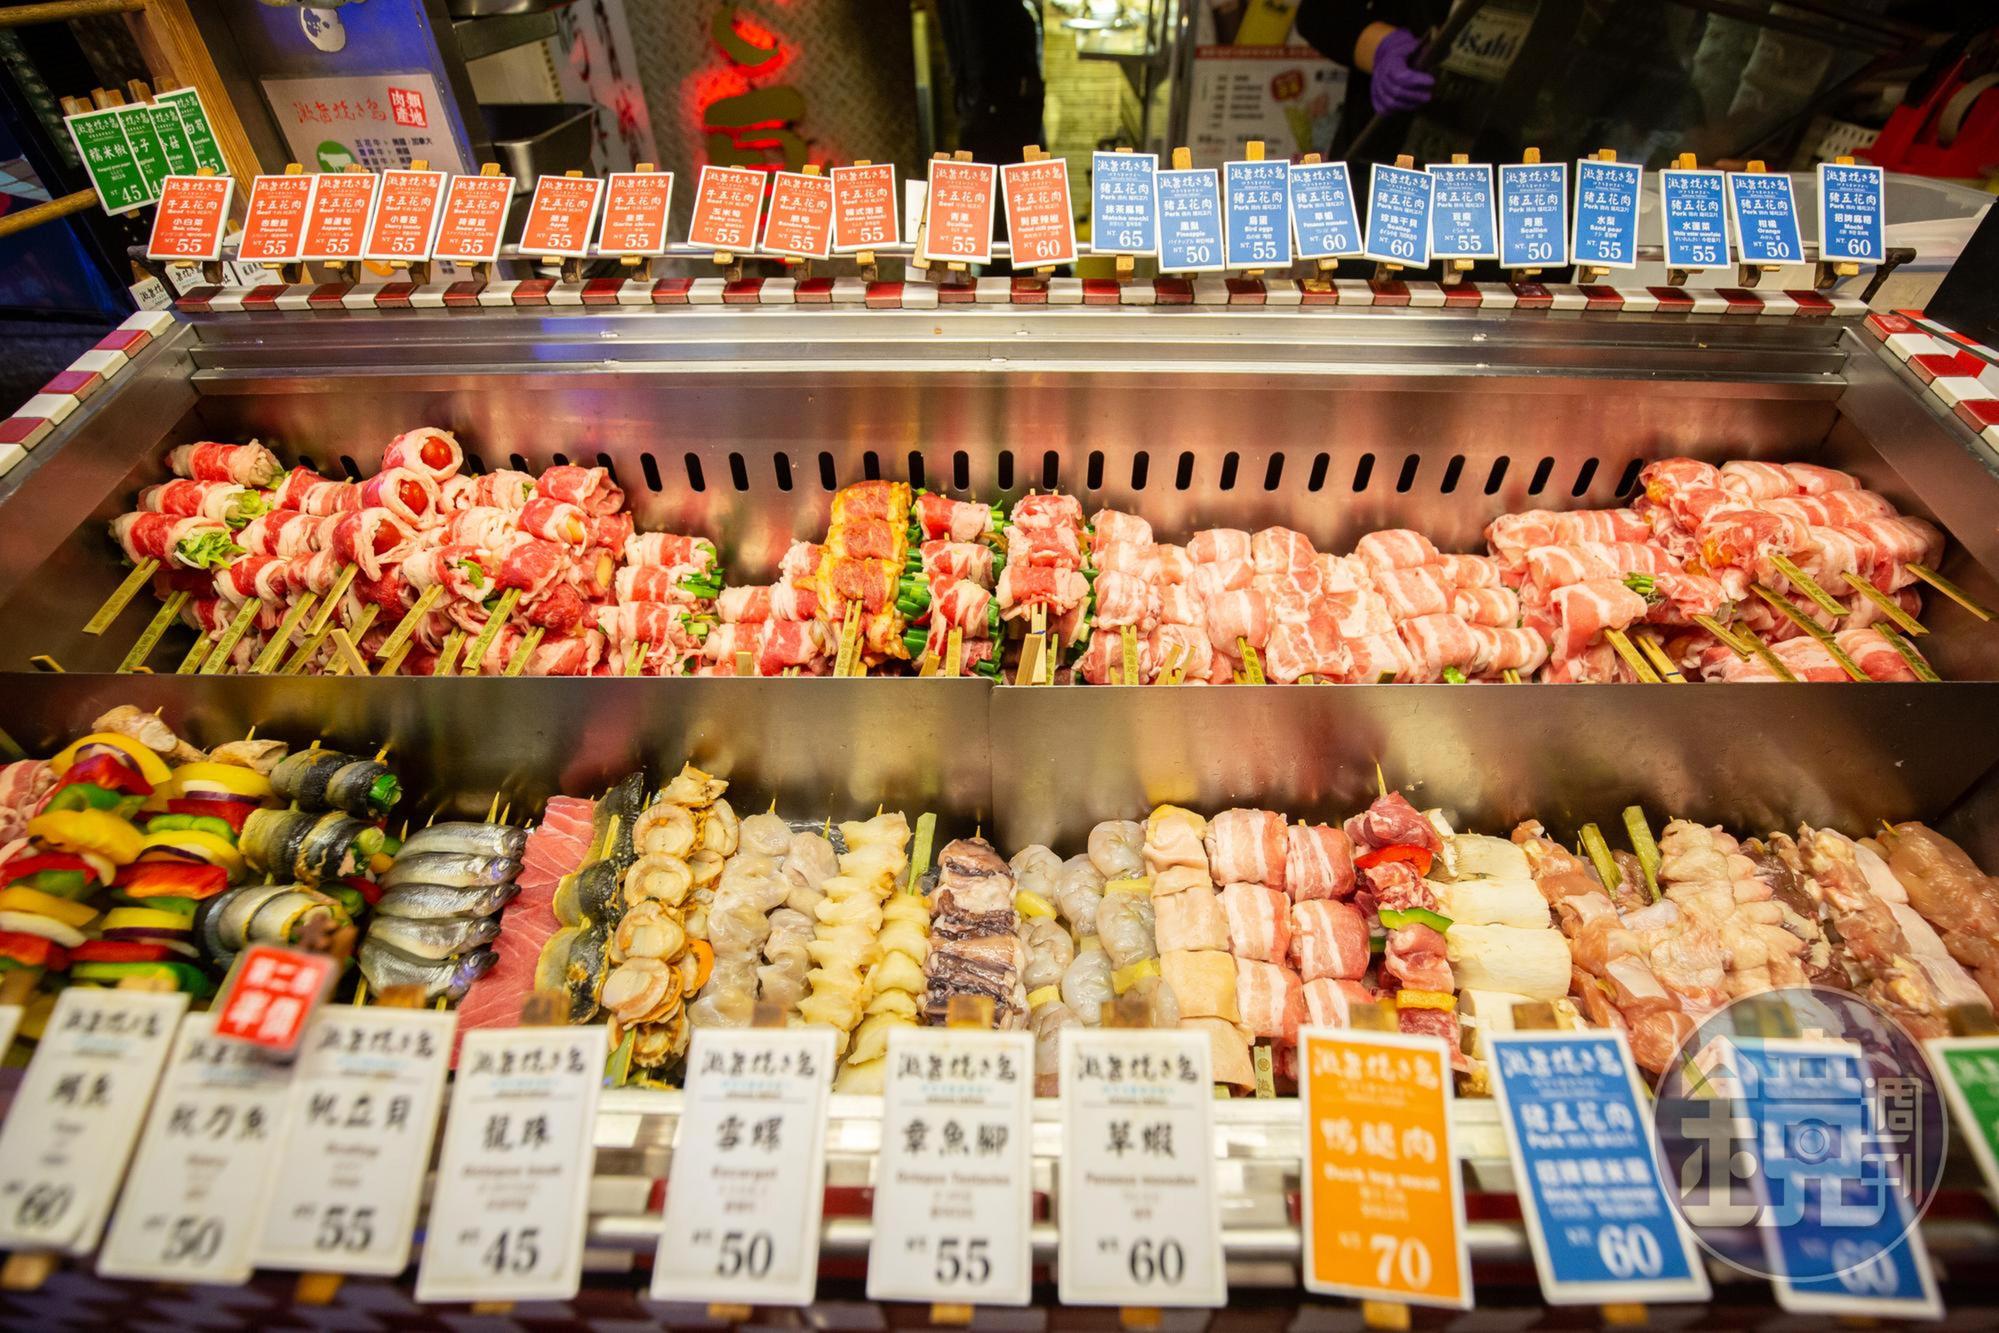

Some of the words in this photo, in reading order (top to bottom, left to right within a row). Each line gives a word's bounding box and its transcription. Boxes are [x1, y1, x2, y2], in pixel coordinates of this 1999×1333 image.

[88, 143, 128, 163] 糯米椒
[122, 184, 142, 204] 45
[706, 188, 754, 201] 牛五花肉
[840, 188, 887, 198] 牛五花肉
[1100, 182, 1148, 193] 豬五花肉
[318, 196, 366, 208] 牛五花肉
[385, 195, 432, 205] 牛五花肉
[540, 197, 588, 208] 牛五花肉
[614, 196, 661, 205] 牛五花肉
[779, 195, 827, 209] 牛五花肉
[936, 189, 985, 202] 牛五花肉
[1013, 190, 1062, 205] 牛五花肉
[1234, 191, 1282, 203] 豬五花肉
[1295, 189, 1344, 204] 豬五花肉
[1377, 191, 1424, 210] 豬五花肉
[1436, 191, 1485, 202] 豬五花肉
[1509, 193, 1557, 206] 豬五花肉
[1583, 191, 1630, 206] 豬五花肉
[1829, 191, 1876, 205] 豬五花肉
[166, 199, 217, 209] 牛五花肉
[256, 198, 302, 209] 牛五花肉
[453, 199, 500, 210] 牛五花肉
[1164, 198, 1212, 210] 豬五花肉
[1376, 202, 1390, 210] Pork
[1671, 199, 1718, 211] 豬五花肉
[1740, 198, 1788, 210] 豬五花肉
[1597, 215, 1615, 225] 水梨
[546, 233, 573, 247] 55
[624, 234, 649, 247] 55
[714, 227, 741, 243] 55
[859, 227, 884, 241] 55
[1119, 229, 1142, 246] 65
[175, 238, 202, 252] 55
[261, 239, 287, 254] 55
[324, 238, 350, 252] 55
[391, 237, 416, 251] 55
[458, 239, 485, 253] 55
[788, 234, 814, 251] 55
[951, 236, 976, 252] 55
[1035, 239, 1061, 257] 60
[1321, 233, 1347, 251] 60
[1389, 237, 1414, 258] 60
[1457, 235, 1482, 250] 55
[1598, 240, 1622, 259] 55
[1765, 241, 1790, 257] 50
[1847, 238, 1871, 256] 60
[1185, 245, 1209, 262] 50
[1252, 242, 1276, 259] 55
[1527, 241, 1552, 259] 50
[1692, 245, 1716, 262] 55
[309, 1091, 415, 1133] 帆立貝
[1519, 1101, 1635, 1133] 豬五花肉
[483, 1113, 552, 1151] 龍珠
[717, 1116, 784, 1153] 雪螺
[903, 1118, 1009, 1157] 章魚腳
[1105, 1120, 1177, 1159] 草蝦
[1320, 1117, 1438, 1164] 鴨腿肉
[1323, 1163, 1363, 1183] Duck
[1399, 1171, 1441, 1192] meat
[315, 1206, 376, 1252] 55
[163, 1216, 225, 1263] 50
[482, 1228, 541, 1275] 45
[717, 1231, 774, 1279] 50
[1598, 1223, 1664, 1279] 60
[934, 1236, 993, 1285] 55
[1128, 1238, 1186, 1287] 60
[1370, 1232, 1432, 1289] 70
